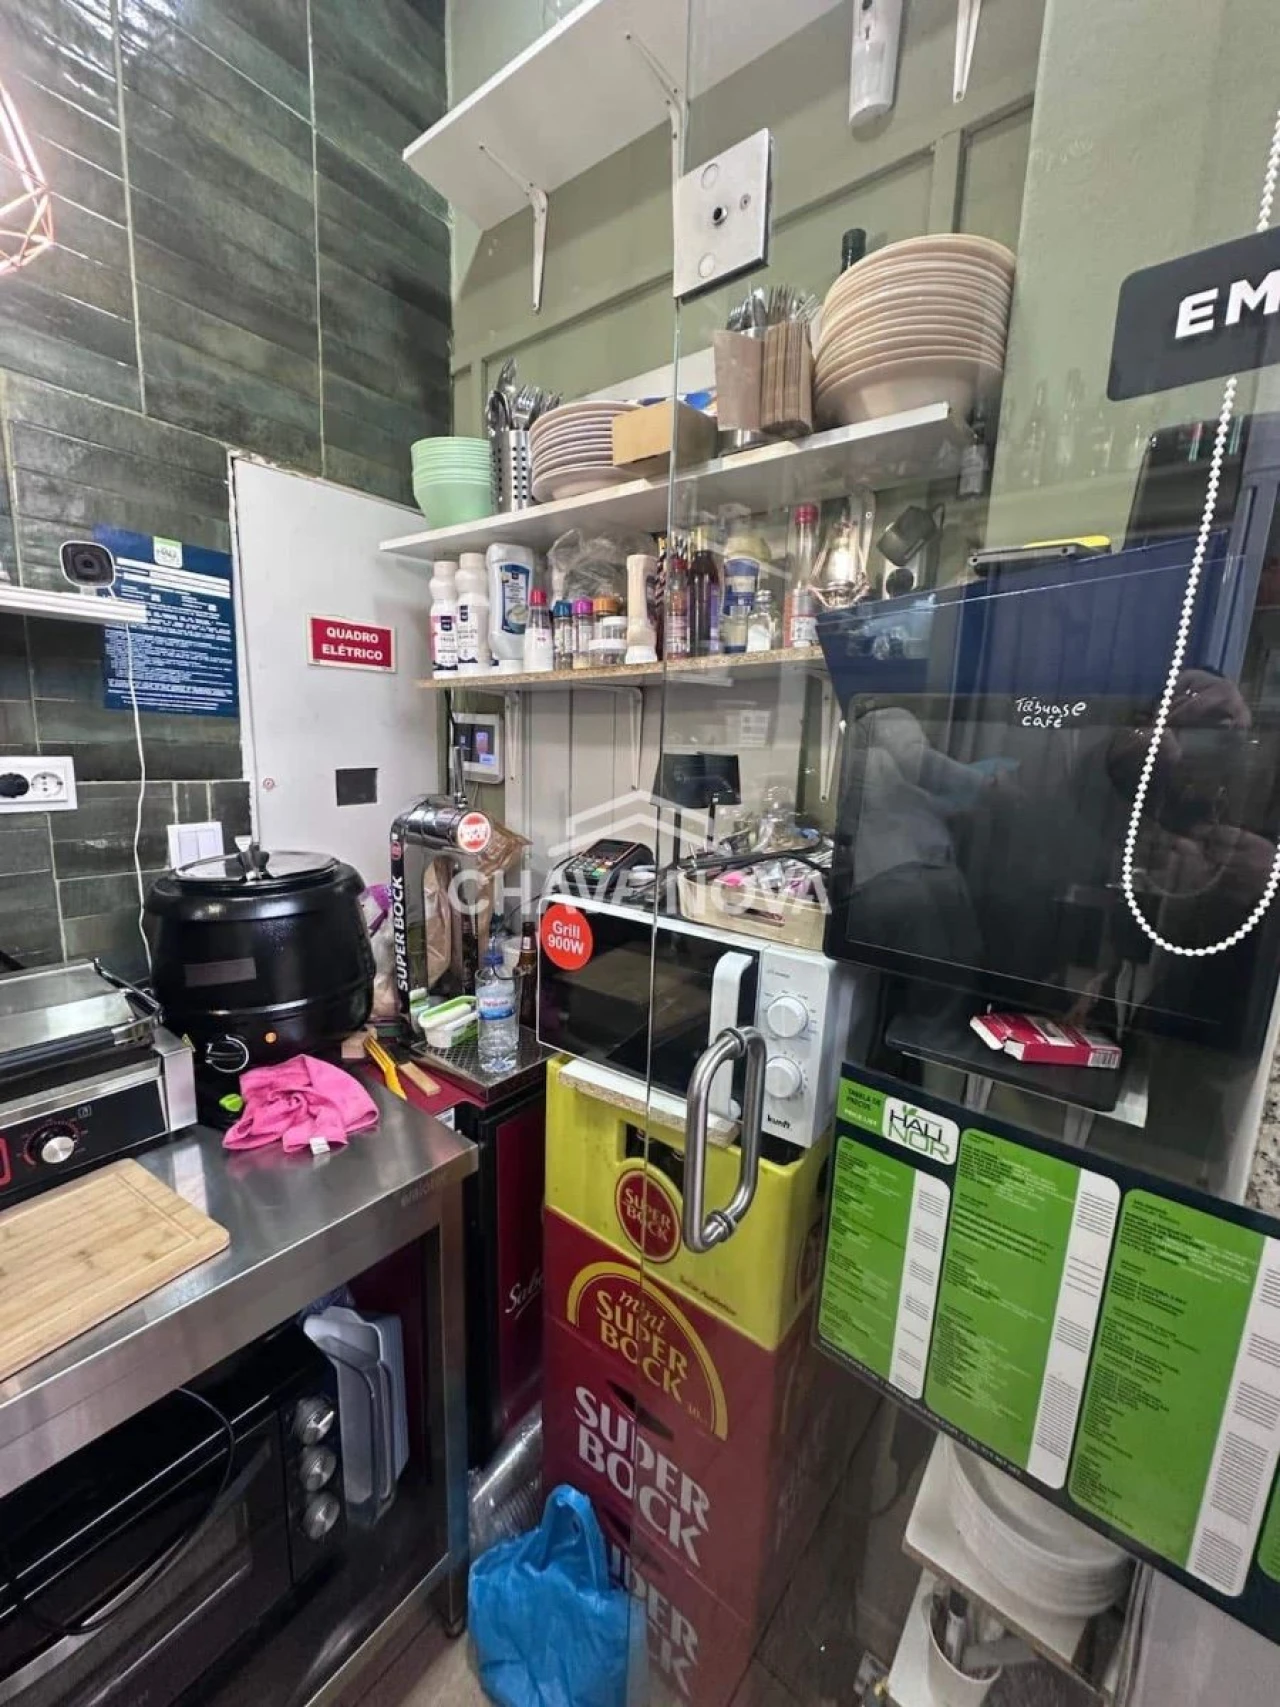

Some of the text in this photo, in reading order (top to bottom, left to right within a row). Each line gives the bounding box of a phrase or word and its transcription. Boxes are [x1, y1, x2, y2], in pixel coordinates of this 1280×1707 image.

[322, 643, 384, 661] ELÉTRICO
[326, 626, 379, 644] QUADRO
[392, 875, 409, 992] SUPER BOCK
[548, 934, 584, 955] 900W
[552, 920, 581, 940] Grill
[622, 1187, 671, 1231] SUPER
[627, 1203, 668, 1243] BOCK
[619, 1290, 667, 1334] mini
[596, 1289, 688, 1380] SUPER
[600, 1319, 682, 1404] BOCK
[574, 1386, 710, 1532] SUPER
[579, 1424, 701, 1567] BOCK
